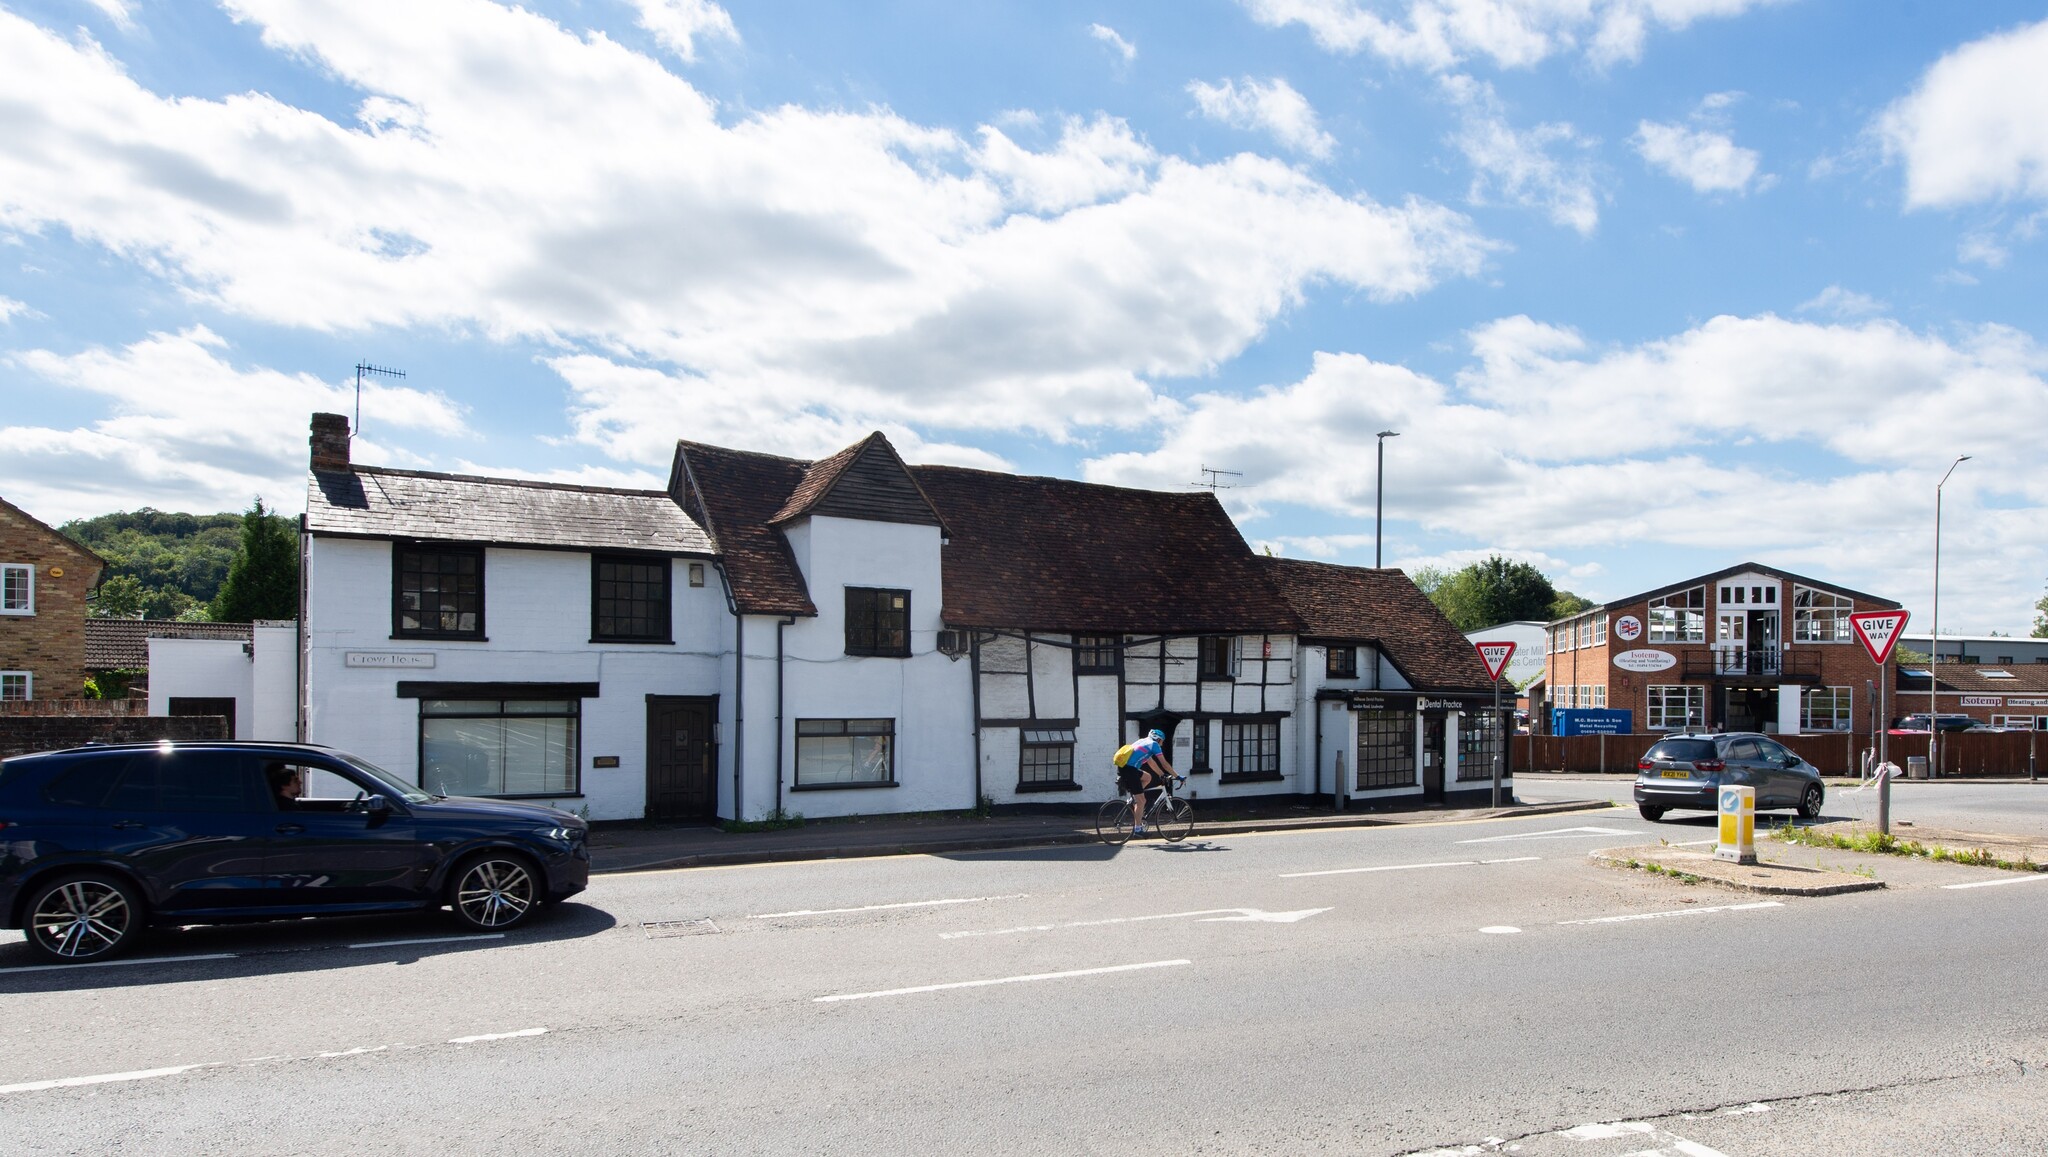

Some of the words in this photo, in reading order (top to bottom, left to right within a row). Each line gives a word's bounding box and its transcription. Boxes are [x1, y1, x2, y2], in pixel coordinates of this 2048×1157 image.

[1862, 619, 1894, 630] GIVE
[1869, 632, 1889, 640] WAY
[1483, 647, 1506, 656] GIVE
[1530, 646, 1544, 656] Mill
[1631, 651, 1660, 659] Isotemp
[1424, 698, 1442, 708] Dental
[1442, 699, 1463, 709] Practice
[1961, 695, 2002, 706] Isotemp
